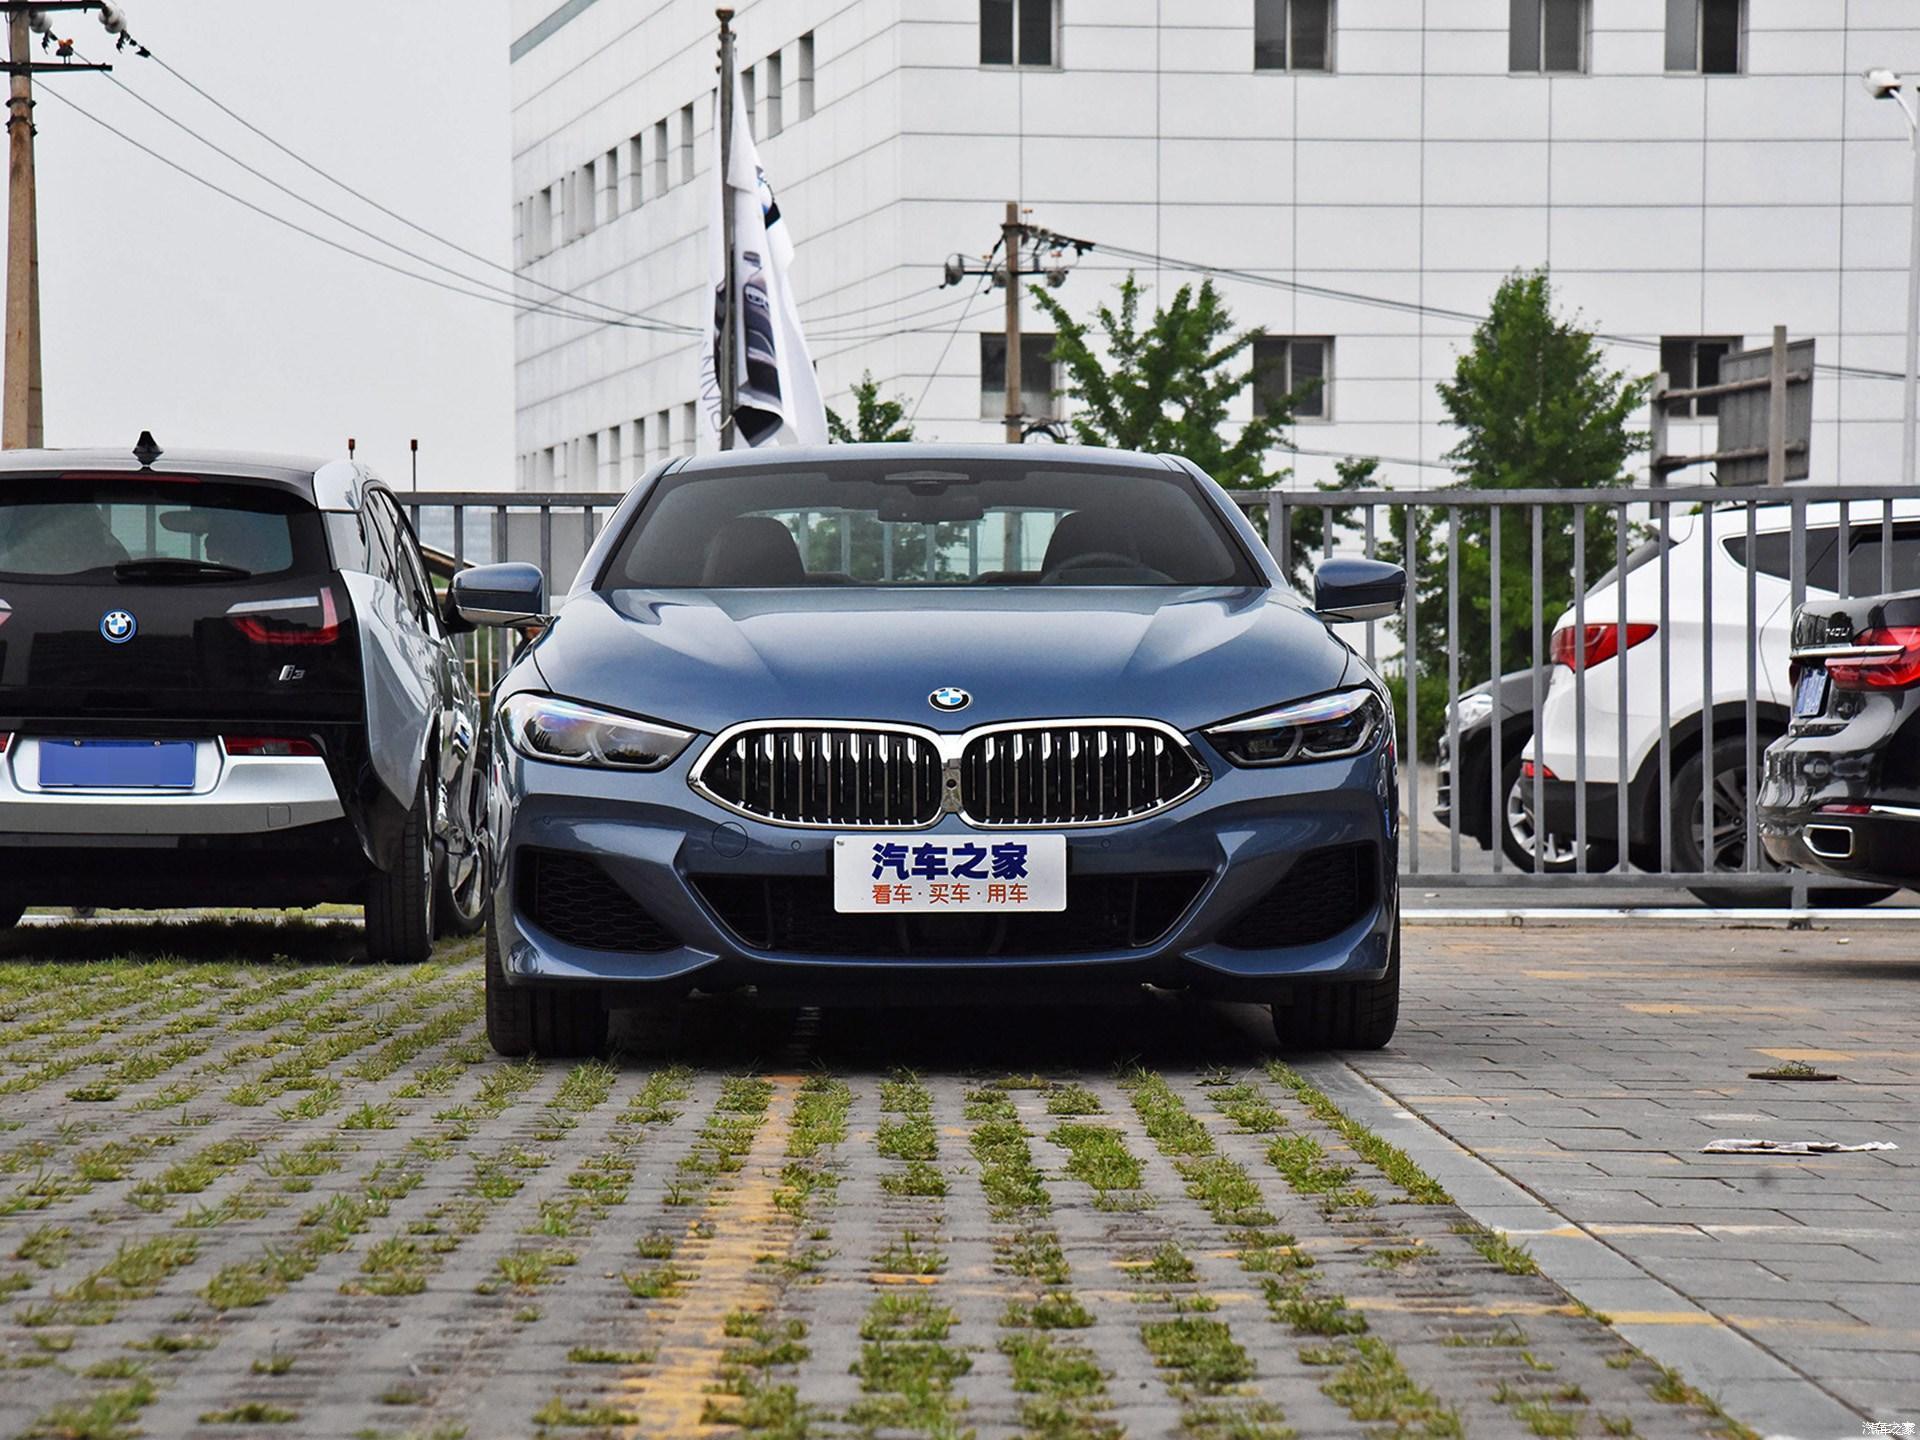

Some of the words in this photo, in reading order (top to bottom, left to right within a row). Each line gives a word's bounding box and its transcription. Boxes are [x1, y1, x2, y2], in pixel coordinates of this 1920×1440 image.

[279, 664, 305, 680] i3
[871, 842, 1028, 881] 汽车之家
